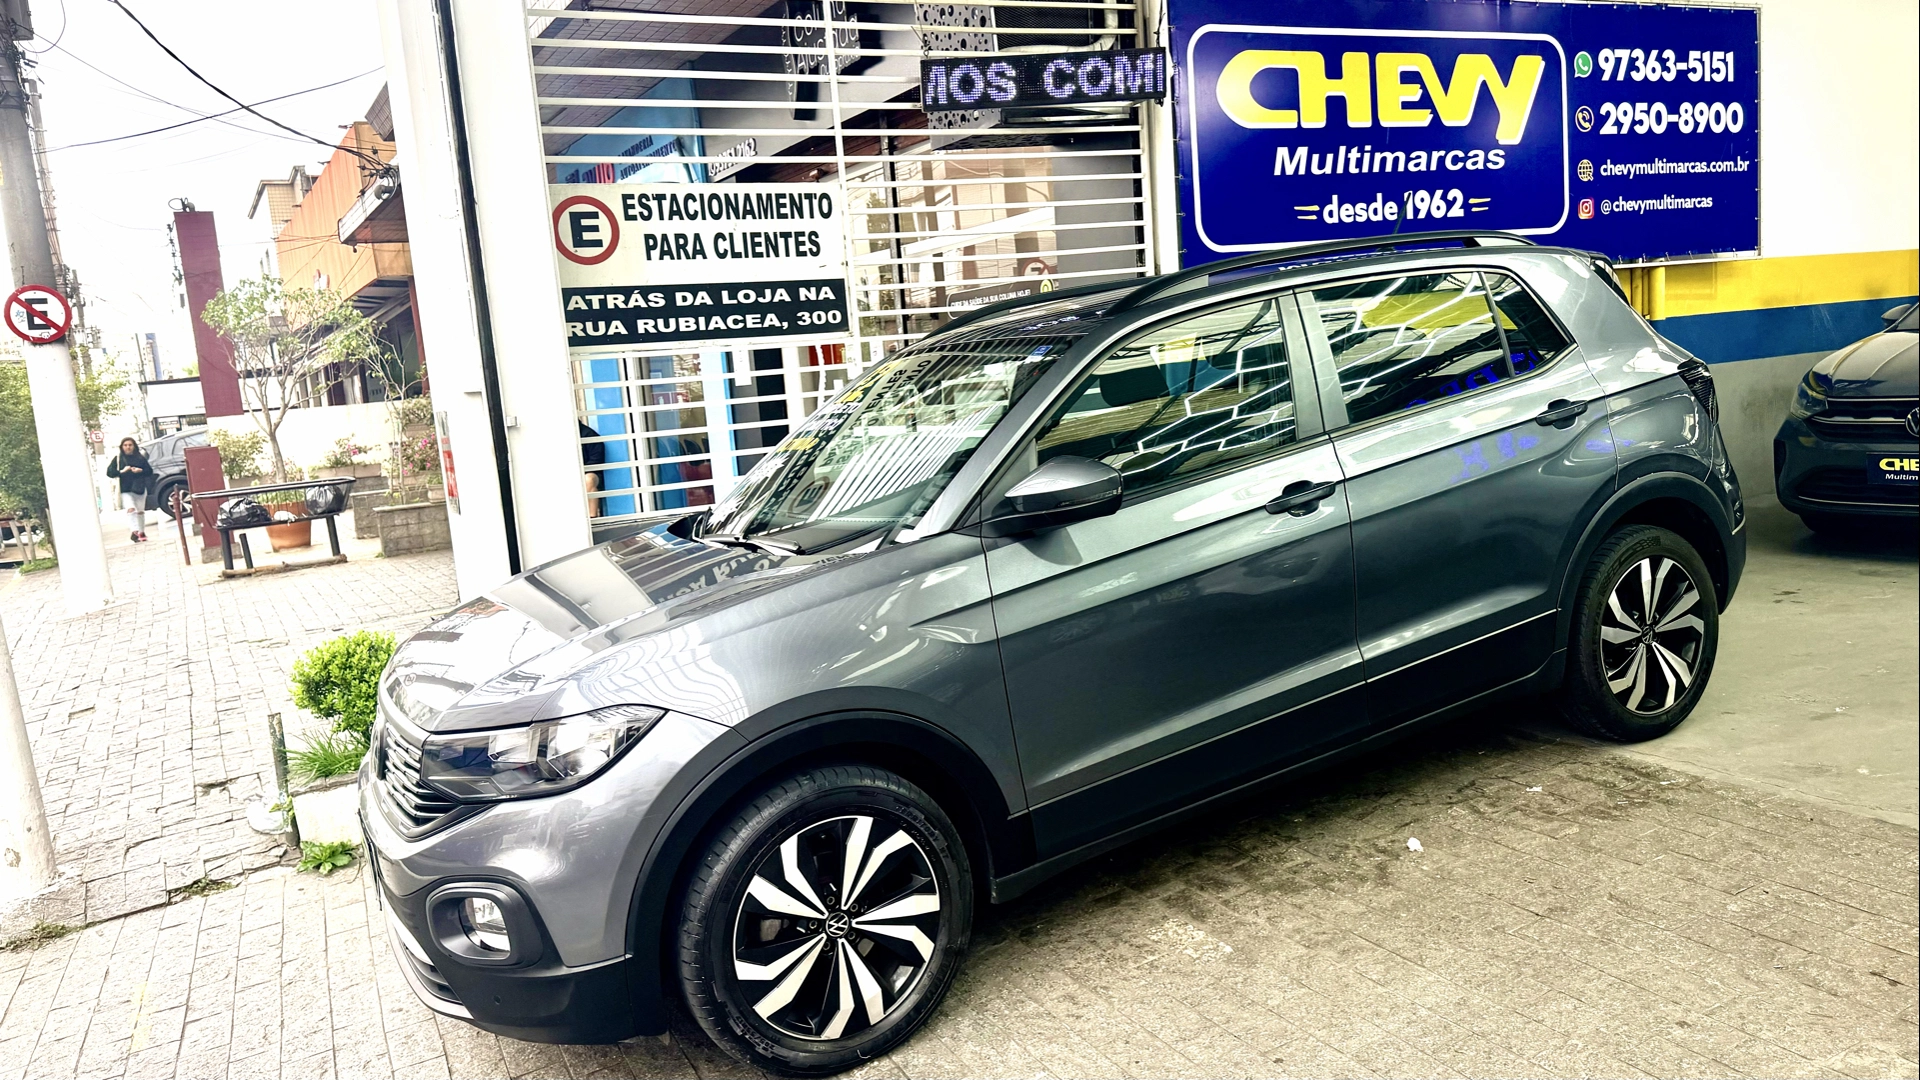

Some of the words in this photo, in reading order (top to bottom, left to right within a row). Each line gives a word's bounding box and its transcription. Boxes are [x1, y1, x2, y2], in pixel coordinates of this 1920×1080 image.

[1597, 49, 1735, 83] 97363-5151
[1215, 49, 1546, 146] CHEVY
[1599, 101, 1745, 135] 2950-8900
[1273, 145, 1507, 177] Multimarcas
[1599, 157, 1750, 179] chevymultimarcas.com.br
[621, 192, 833, 221] ESTACIONAMENTO
[1322, 193, 1399, 224] desde
[1403, 189, 1465, 221] 1962
[569, 211, 604, 248] E
[644, 232, 708, 261] PARA
[713, 230, 821, 259] CLIENTES
[25, 298, 51, 330] E
[567, 290, 666, 311] ATRÁS
[675, 291, 714, 307] DA
[721, 288, 792, 306] LOJA
[798, 286, 836, 301] NA
[567, 320, 627, 337] RUA
[637, 313, 789, 334] RUBIACEA,
[796, 310, 843, 326] 300
